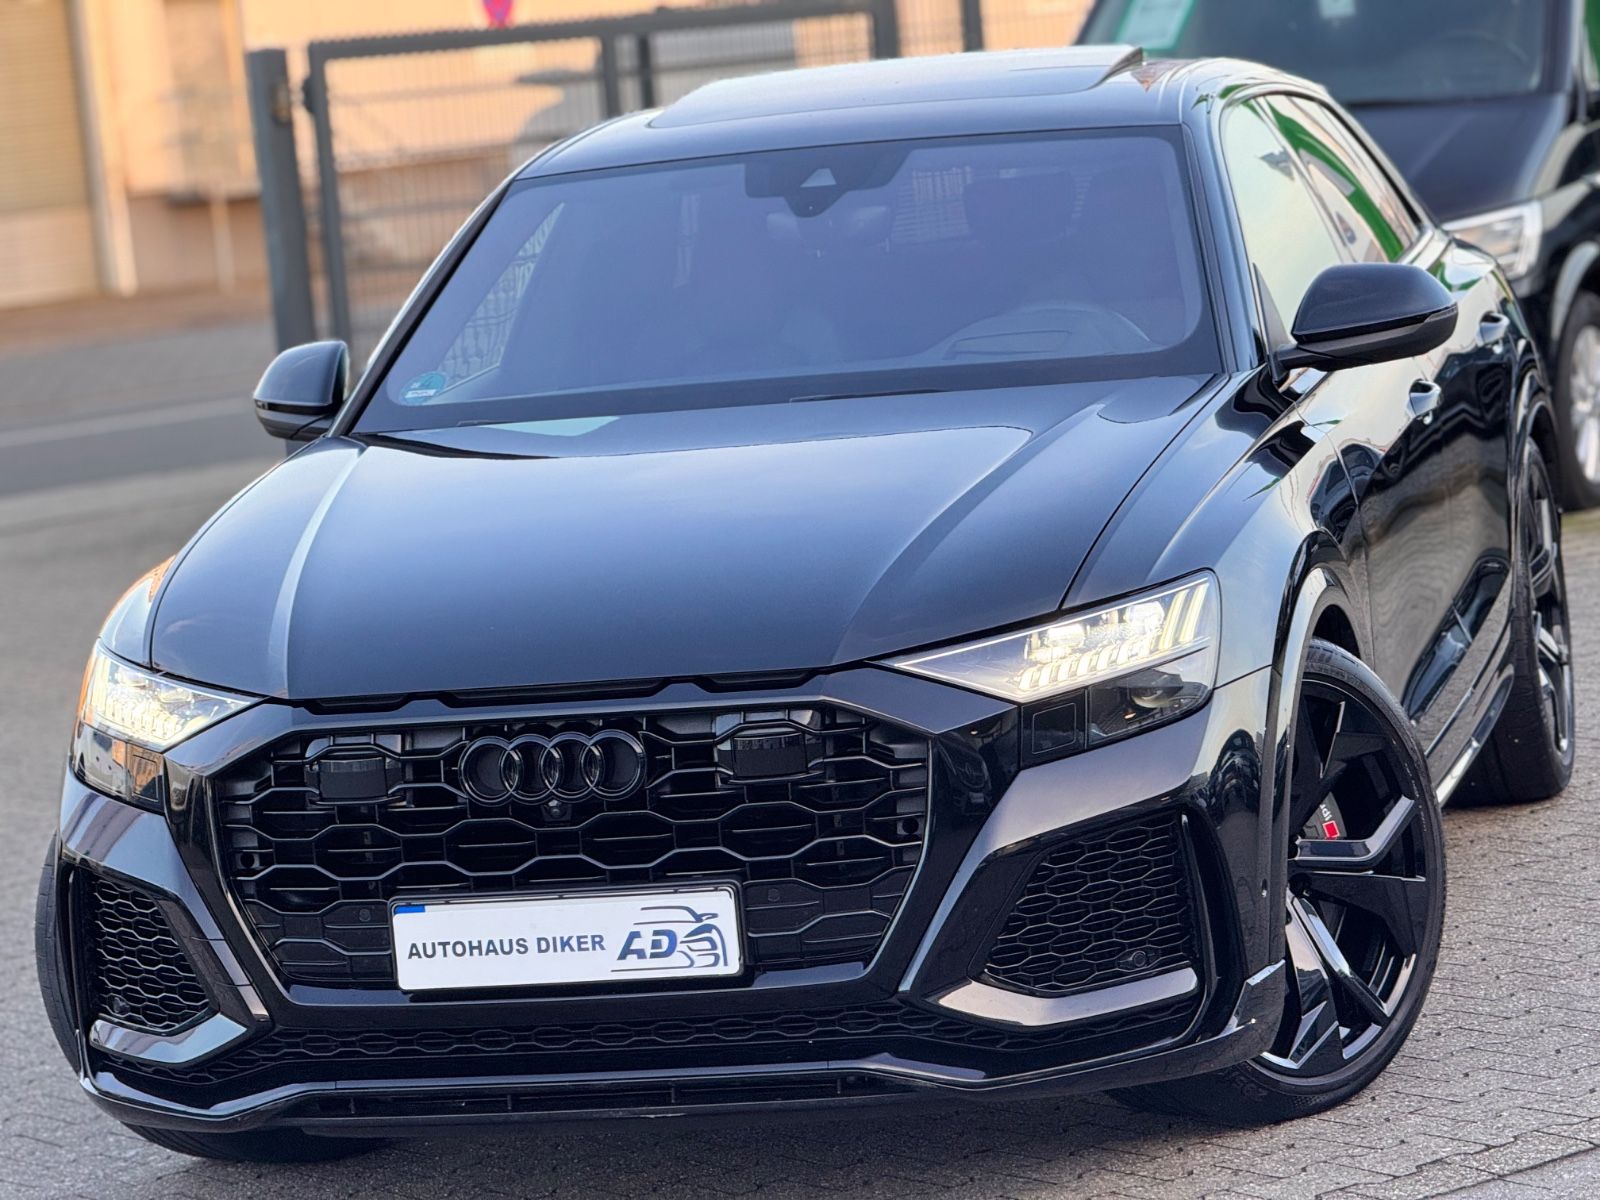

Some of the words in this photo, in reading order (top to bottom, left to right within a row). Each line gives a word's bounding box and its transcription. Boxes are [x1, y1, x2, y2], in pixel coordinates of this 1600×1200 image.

[407, 937, 529, 960] AUTOHAUS
[536, 934, 606, 953] DIKER
[616, 929, 678, 961] AD
